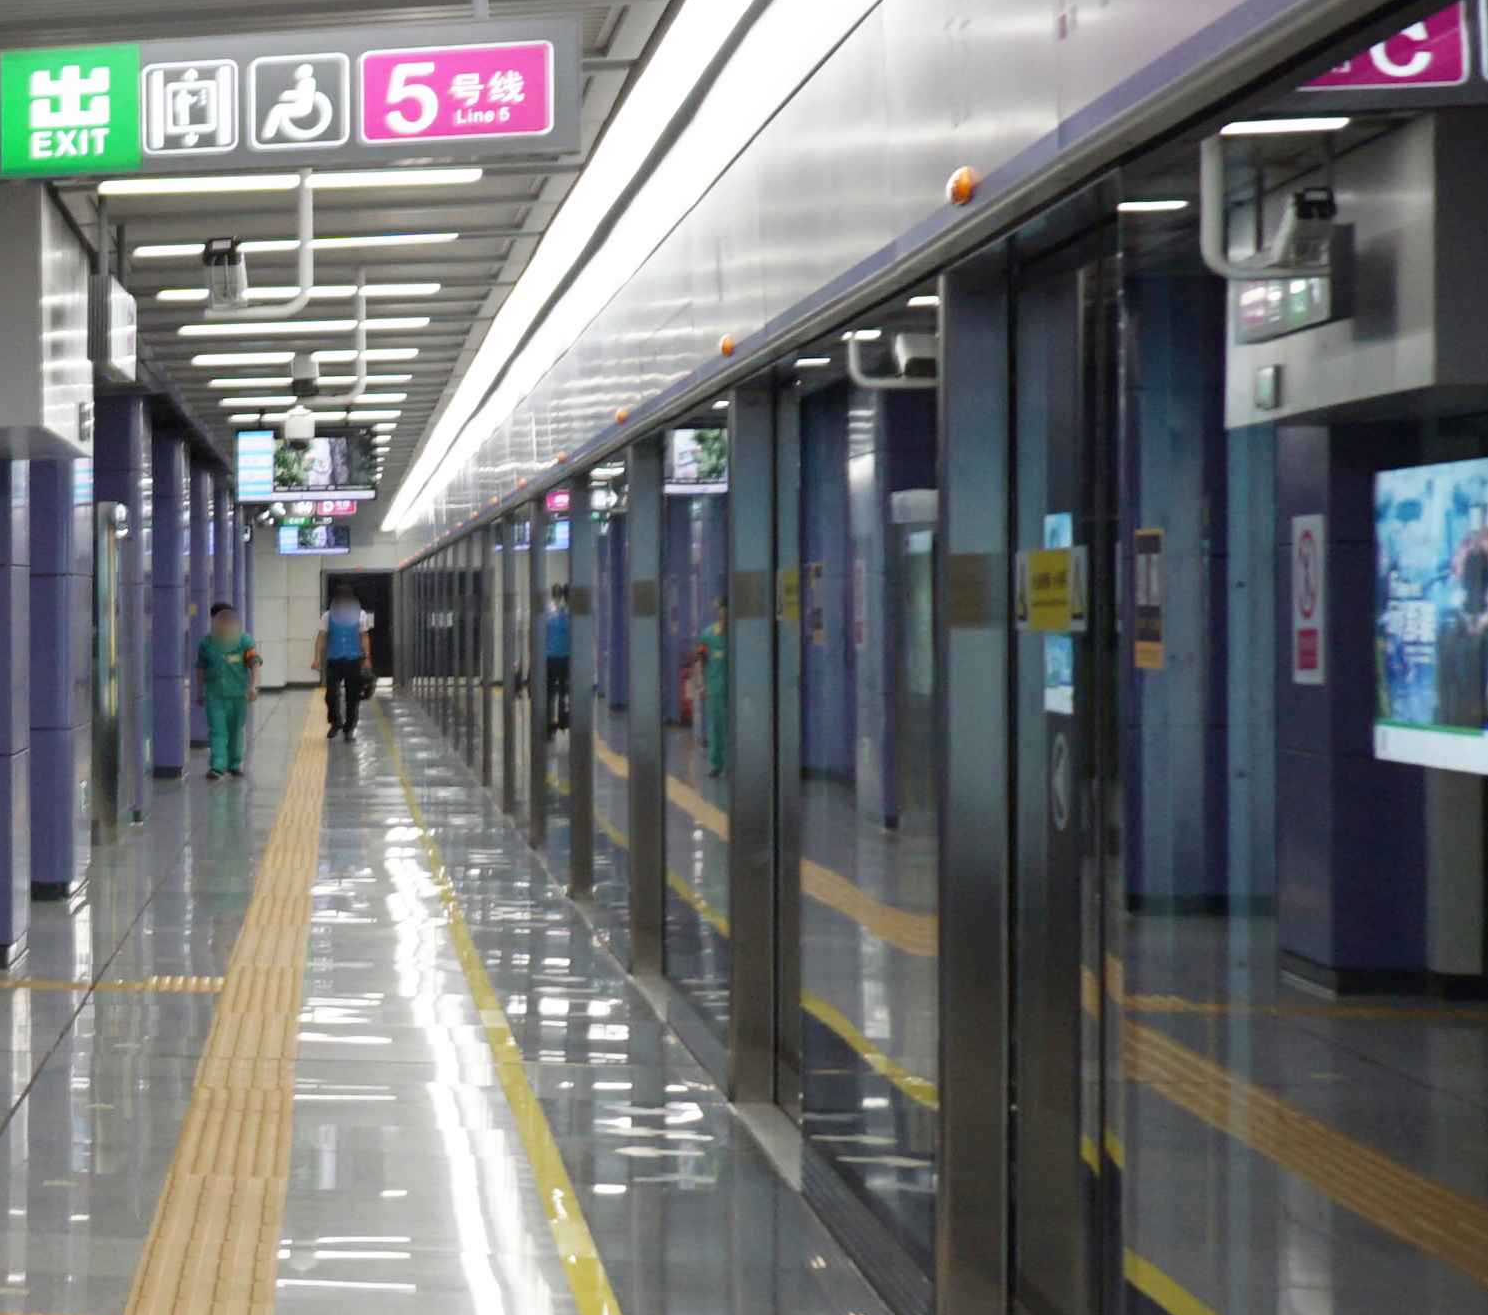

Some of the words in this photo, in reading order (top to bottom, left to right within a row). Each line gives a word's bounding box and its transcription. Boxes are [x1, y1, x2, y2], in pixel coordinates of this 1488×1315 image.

[31, 65, 110, 127] 出
[387, 61, 526, 133] 5号线
[456, 109, 494, 124] Line
[499, 106, 511, 122] 5
[31, 127, 110, 158] EXIT
